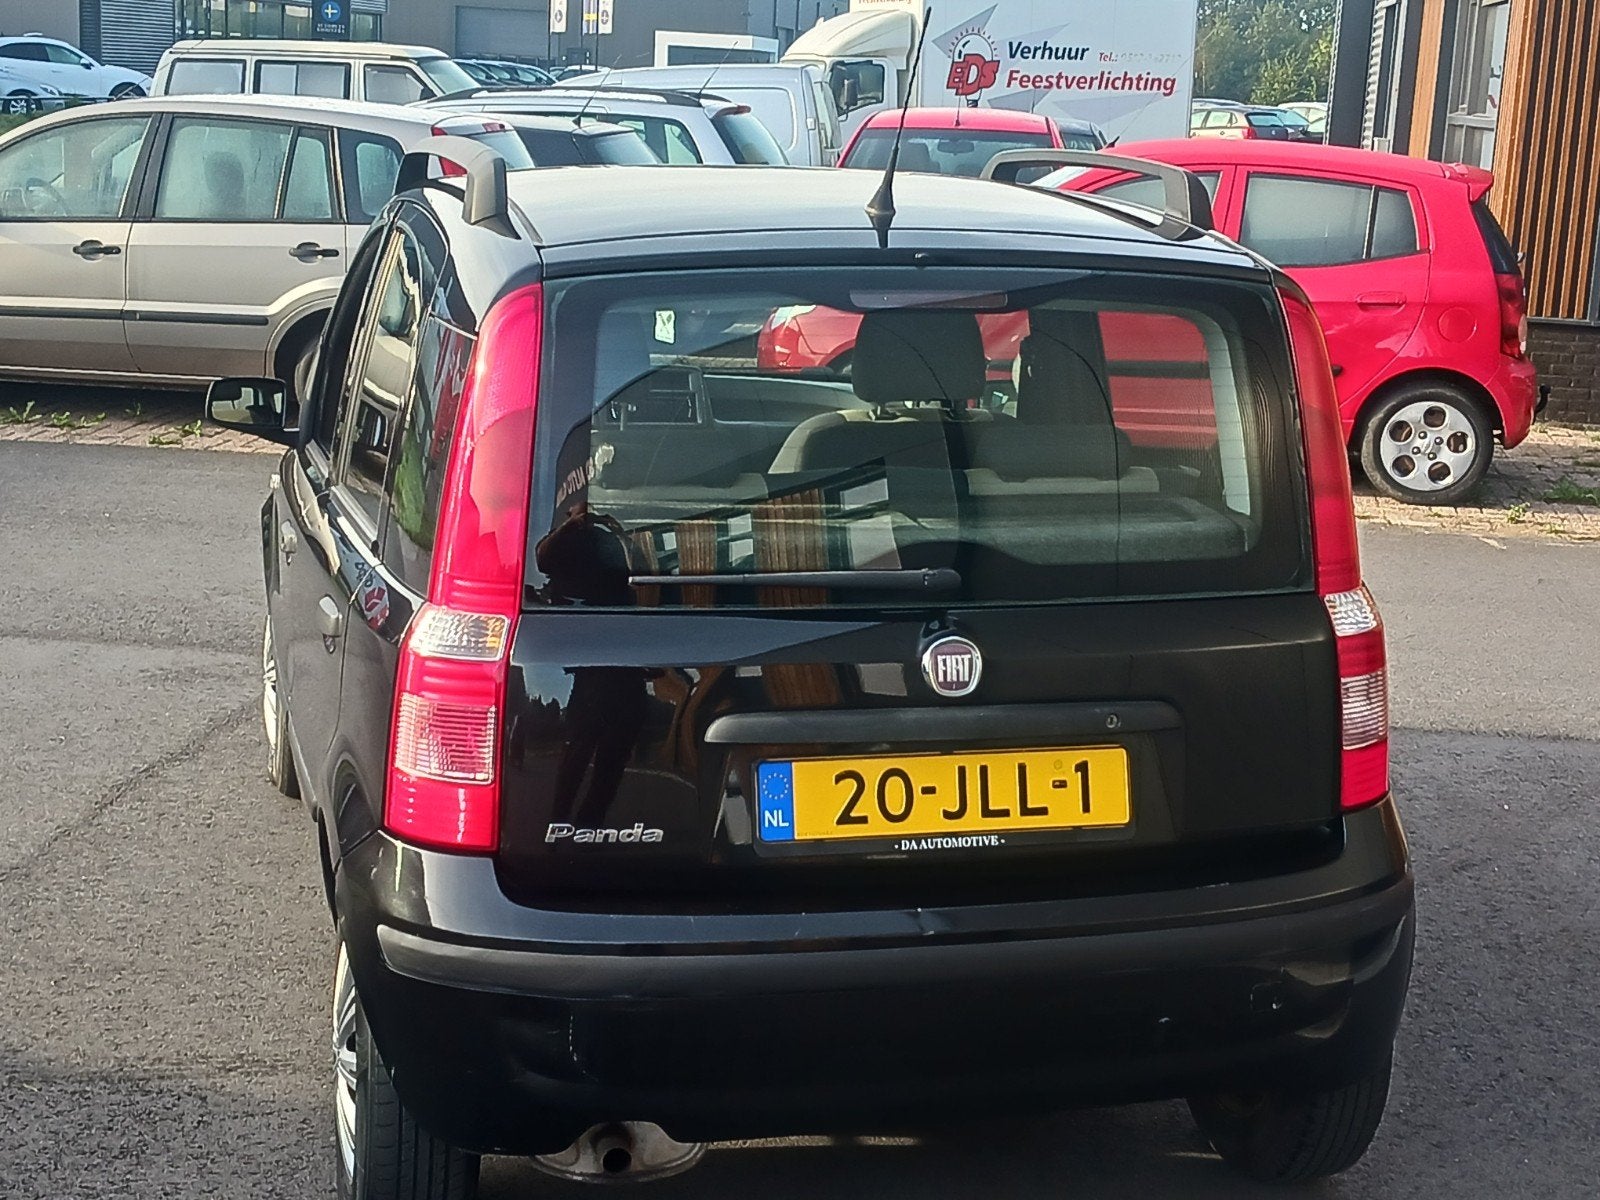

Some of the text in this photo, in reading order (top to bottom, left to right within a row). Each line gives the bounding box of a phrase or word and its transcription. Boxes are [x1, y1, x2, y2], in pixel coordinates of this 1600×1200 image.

[1008, 41, 1090, 61] Verhuur
[947, 53, 1000, 96] EDS
[1006, 69, 1177, 97] Feestverlichting
[937, 654, 971, 683] FIAT
[834, 759, 1092, 826] 20-JLL-1
[544, 822, 664, 843] Panda
[764, 809, 790, 828] NL
